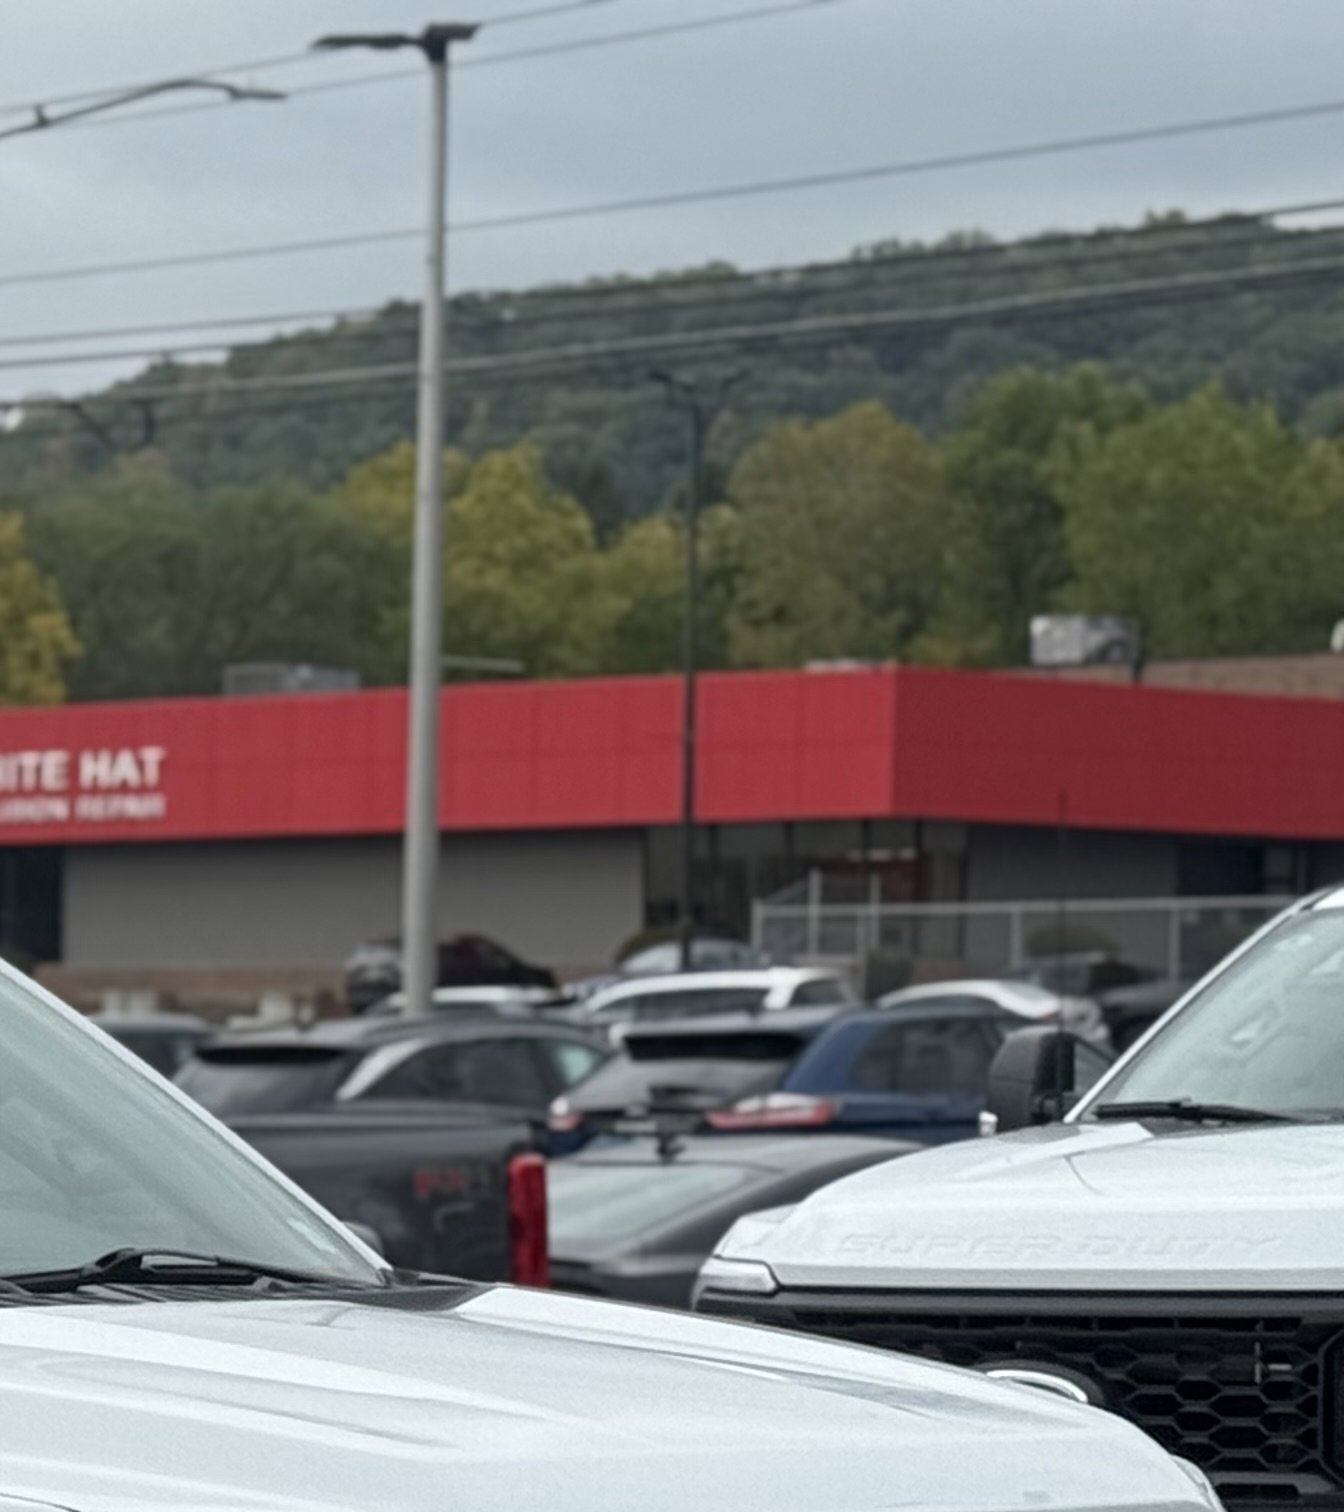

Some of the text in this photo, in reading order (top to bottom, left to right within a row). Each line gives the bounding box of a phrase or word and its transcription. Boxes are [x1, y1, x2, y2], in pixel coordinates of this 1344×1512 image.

[79, 746, 166, 789] HAT
[838, 1233, 1282, 1257] SUPER DUTY
